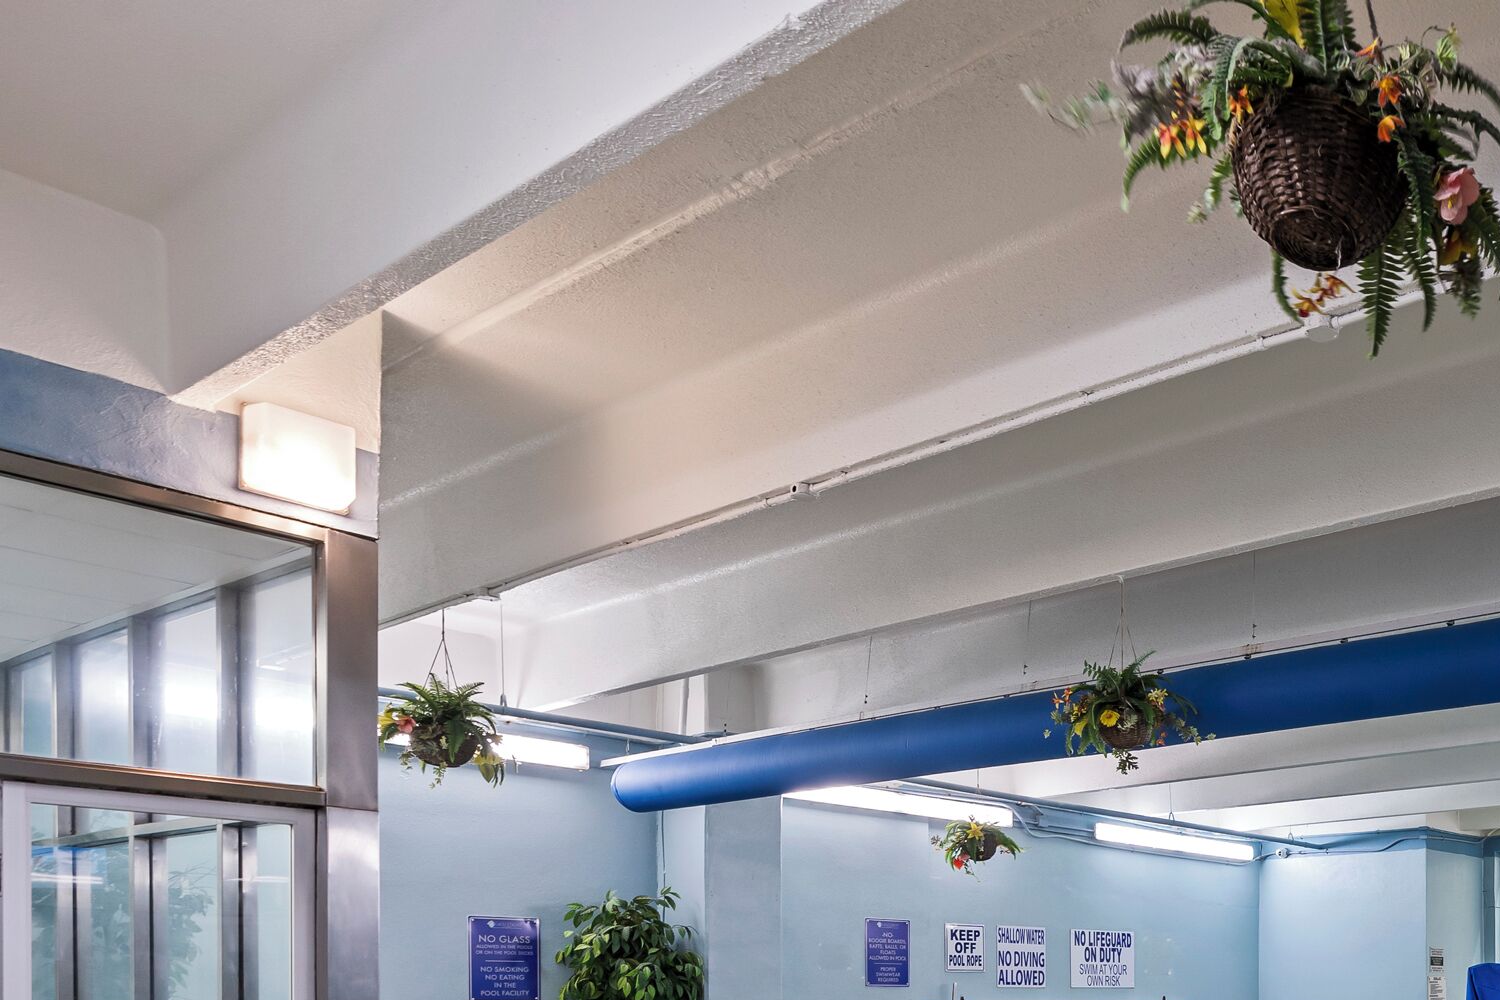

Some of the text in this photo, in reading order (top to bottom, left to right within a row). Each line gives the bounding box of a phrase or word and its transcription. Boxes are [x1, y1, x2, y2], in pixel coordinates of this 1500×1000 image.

[479, 935, 530, 943] NO GLASS
[950, 929, 980, 941] KEEP
[998, 927, 1044, 945] SHALLOW WATER
[1074, 931, 1132, 948] NO LIFEGUARD
[955, 942, 976, 954] OFF
[949, 955, 982, 967] POOL ROPE
[998, 951, 1045, 968] NO DIVING
[1084, 947, 1122, 963] ON DUTY
[1079, 964, 1128, 975] SWIM AT YOUR
[998, 970, 1045, 986] ALLOWED
[1087, 975, 1121, 987] OWN RISK
